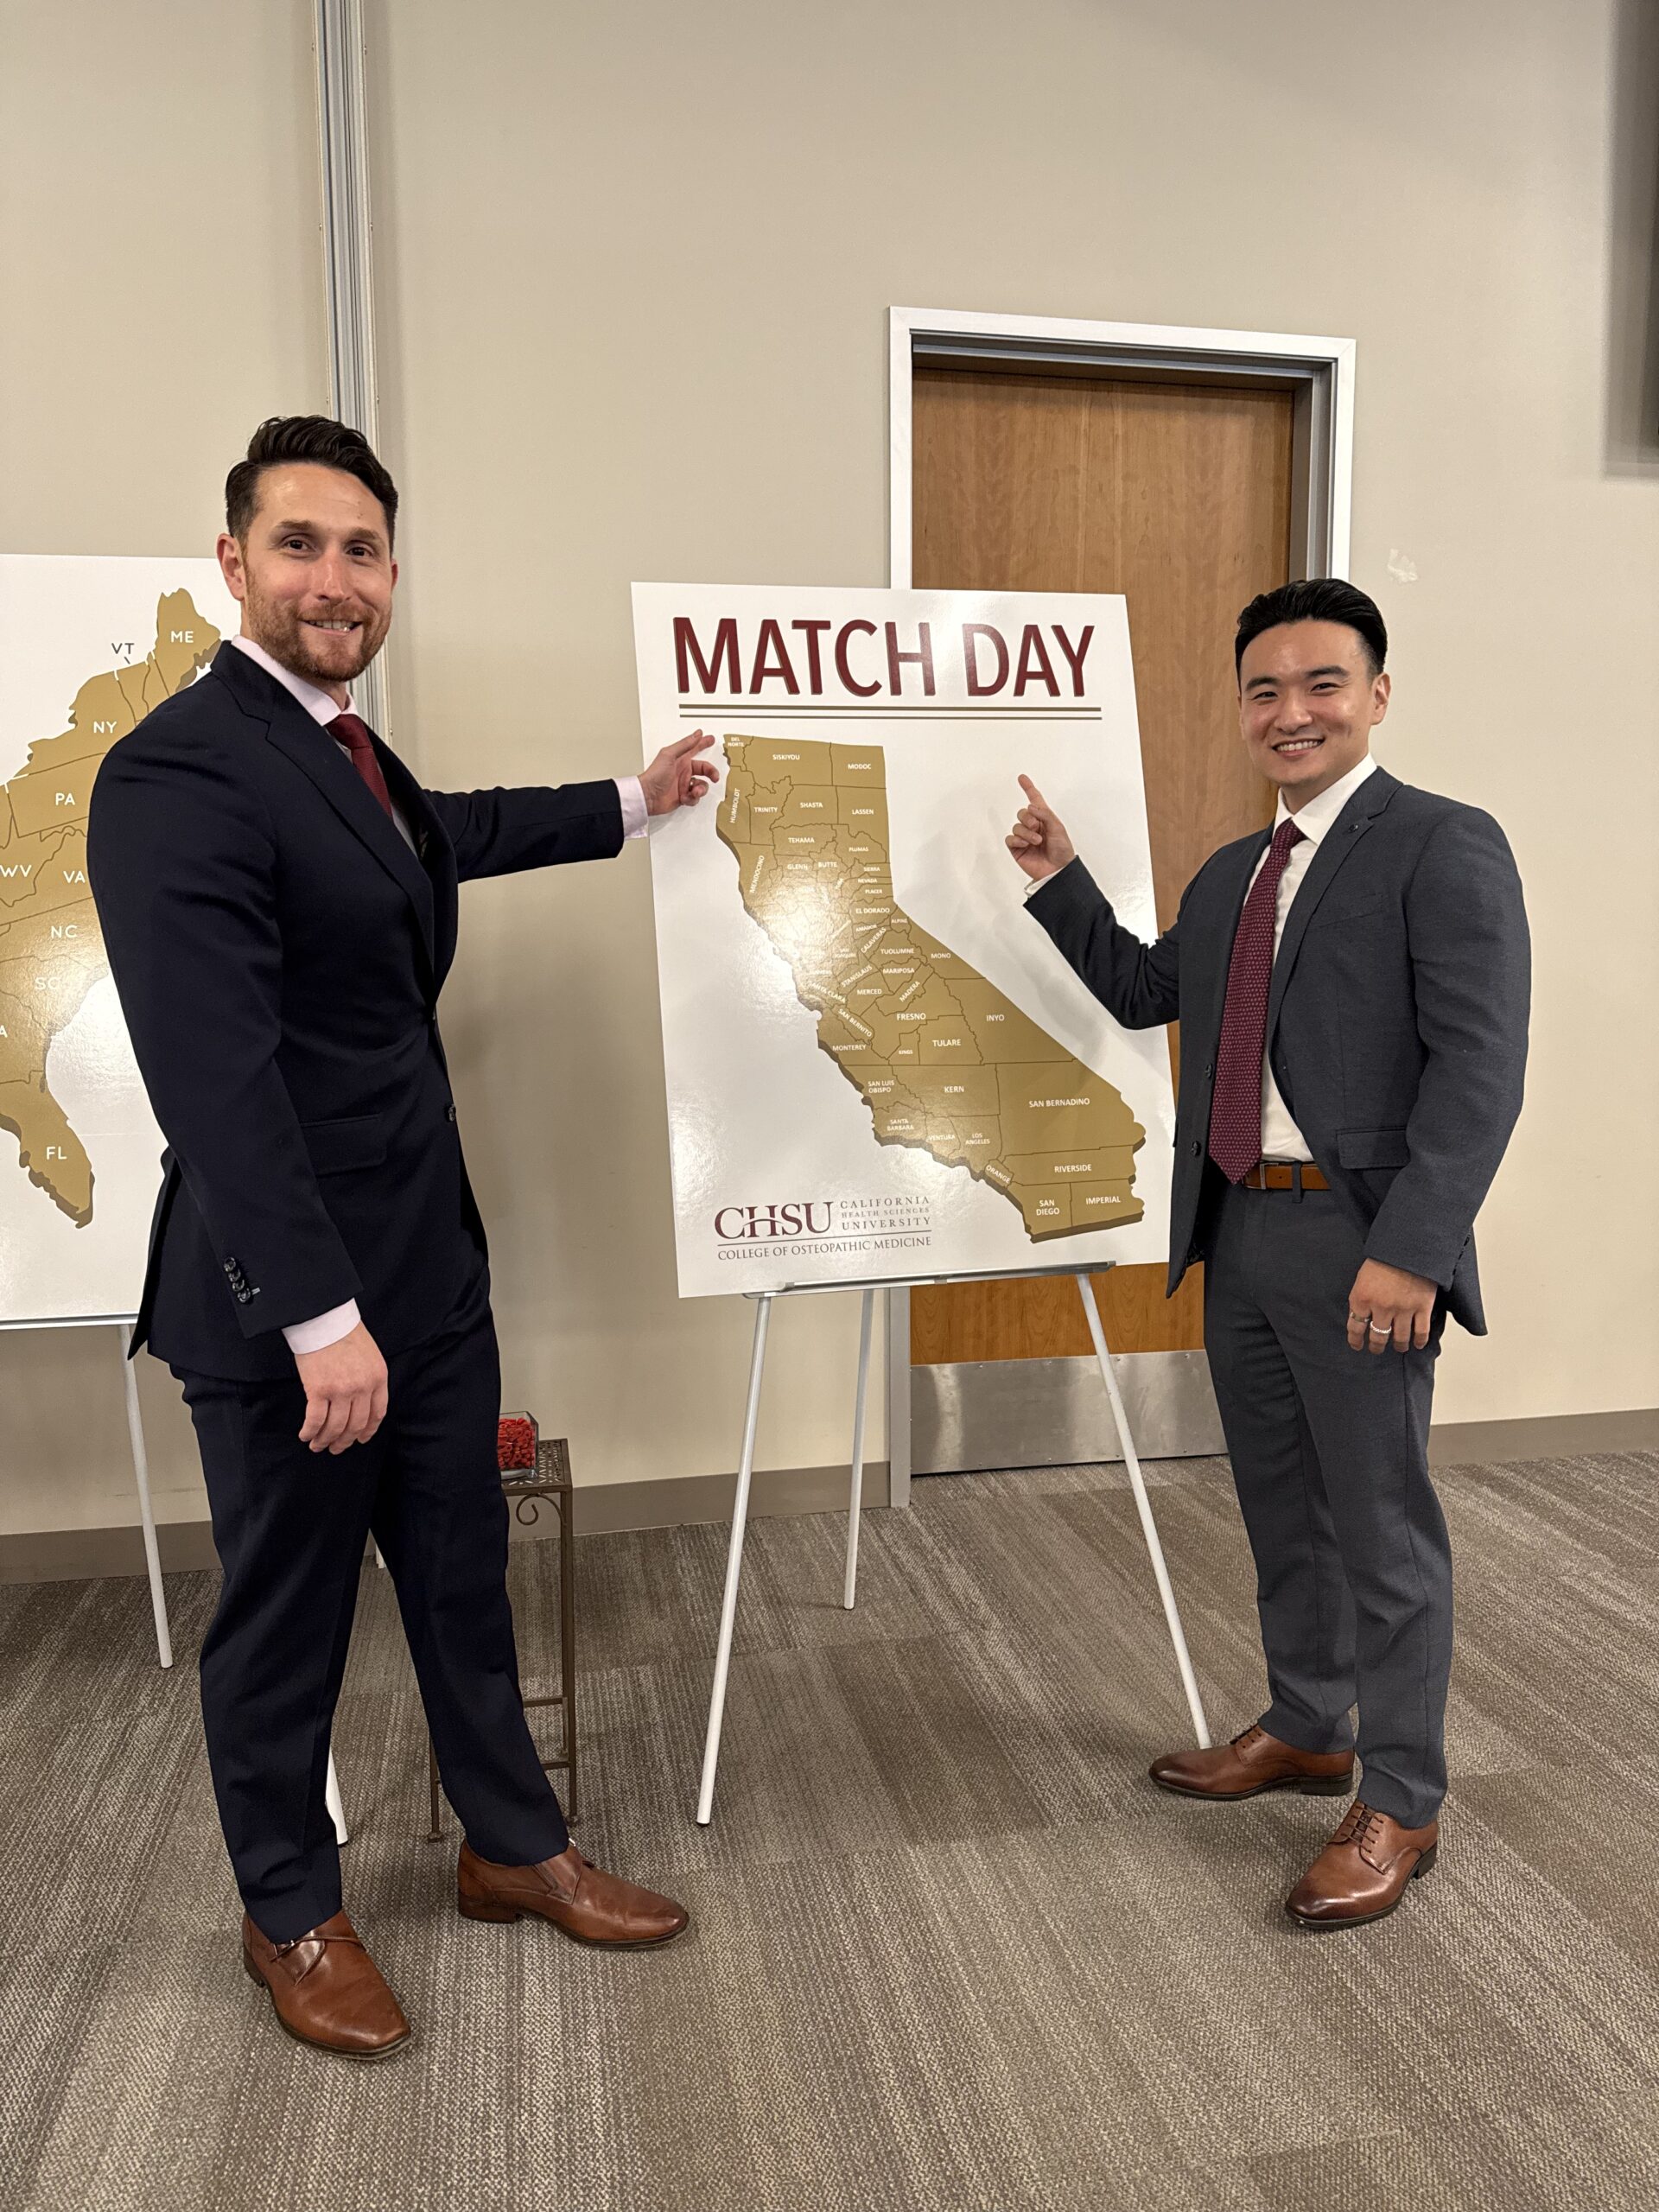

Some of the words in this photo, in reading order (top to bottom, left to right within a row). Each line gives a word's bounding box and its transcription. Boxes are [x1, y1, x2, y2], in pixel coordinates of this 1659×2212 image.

[170, 631, 194, 643] ME
[111, 643, 135, 654] VT
[673, 617, 936, 697] MATCH
[962, 623, 1095, 697] DAY
[92, 721, 118, 734] NY
[55, 793, 76, 805] PA
[730, 788, 741, 823] HUMBOLDT
[0, 865, 32, 878] WV
[63, 870, 86, 883] VA
[749, 855, 765, 894] MENDOCINO
[51, 925, 78, 938] NC
[861, 926, 887, 954] CALAVERAS
[841, 964, 873, 988] STANISLAUS
[35, 977, 61, 989] SC
[899, 981, 921, 1002] MADERA
[837, 1008, 850, 1022] SAN
[849, 1017, 872, 1038] BERNITO
[932, 1039, 961, 1047] TULARE
[1046, 1098, 1090, 1107] BERNADINO
[46, 1147, 67, 1160] FL
[985, 1165, 1011, 1185] ORANGE
[1054, 1164, 1092, 1173] RIVERSIDE
[840, 1196, 930, 1209] CALIFORNIA
[1085, 1196, 1122, 1205] IMPERIAL
[842, 1210, 879, 1218] HEALTH
[883, 1207, 930, 1216] SCIENCES
[715, 1201, 834, 1240] CHSU
[842, 1217, 931, 1230] UNIVERSITY
[717, 1248, 770, 1261] COLLEGE
[772, 1247, 788, 1256] OF
[791, 1239, 871, 1255] OSTEOPATHIC
[874, 1236, 931, 1249] MEDICINE
